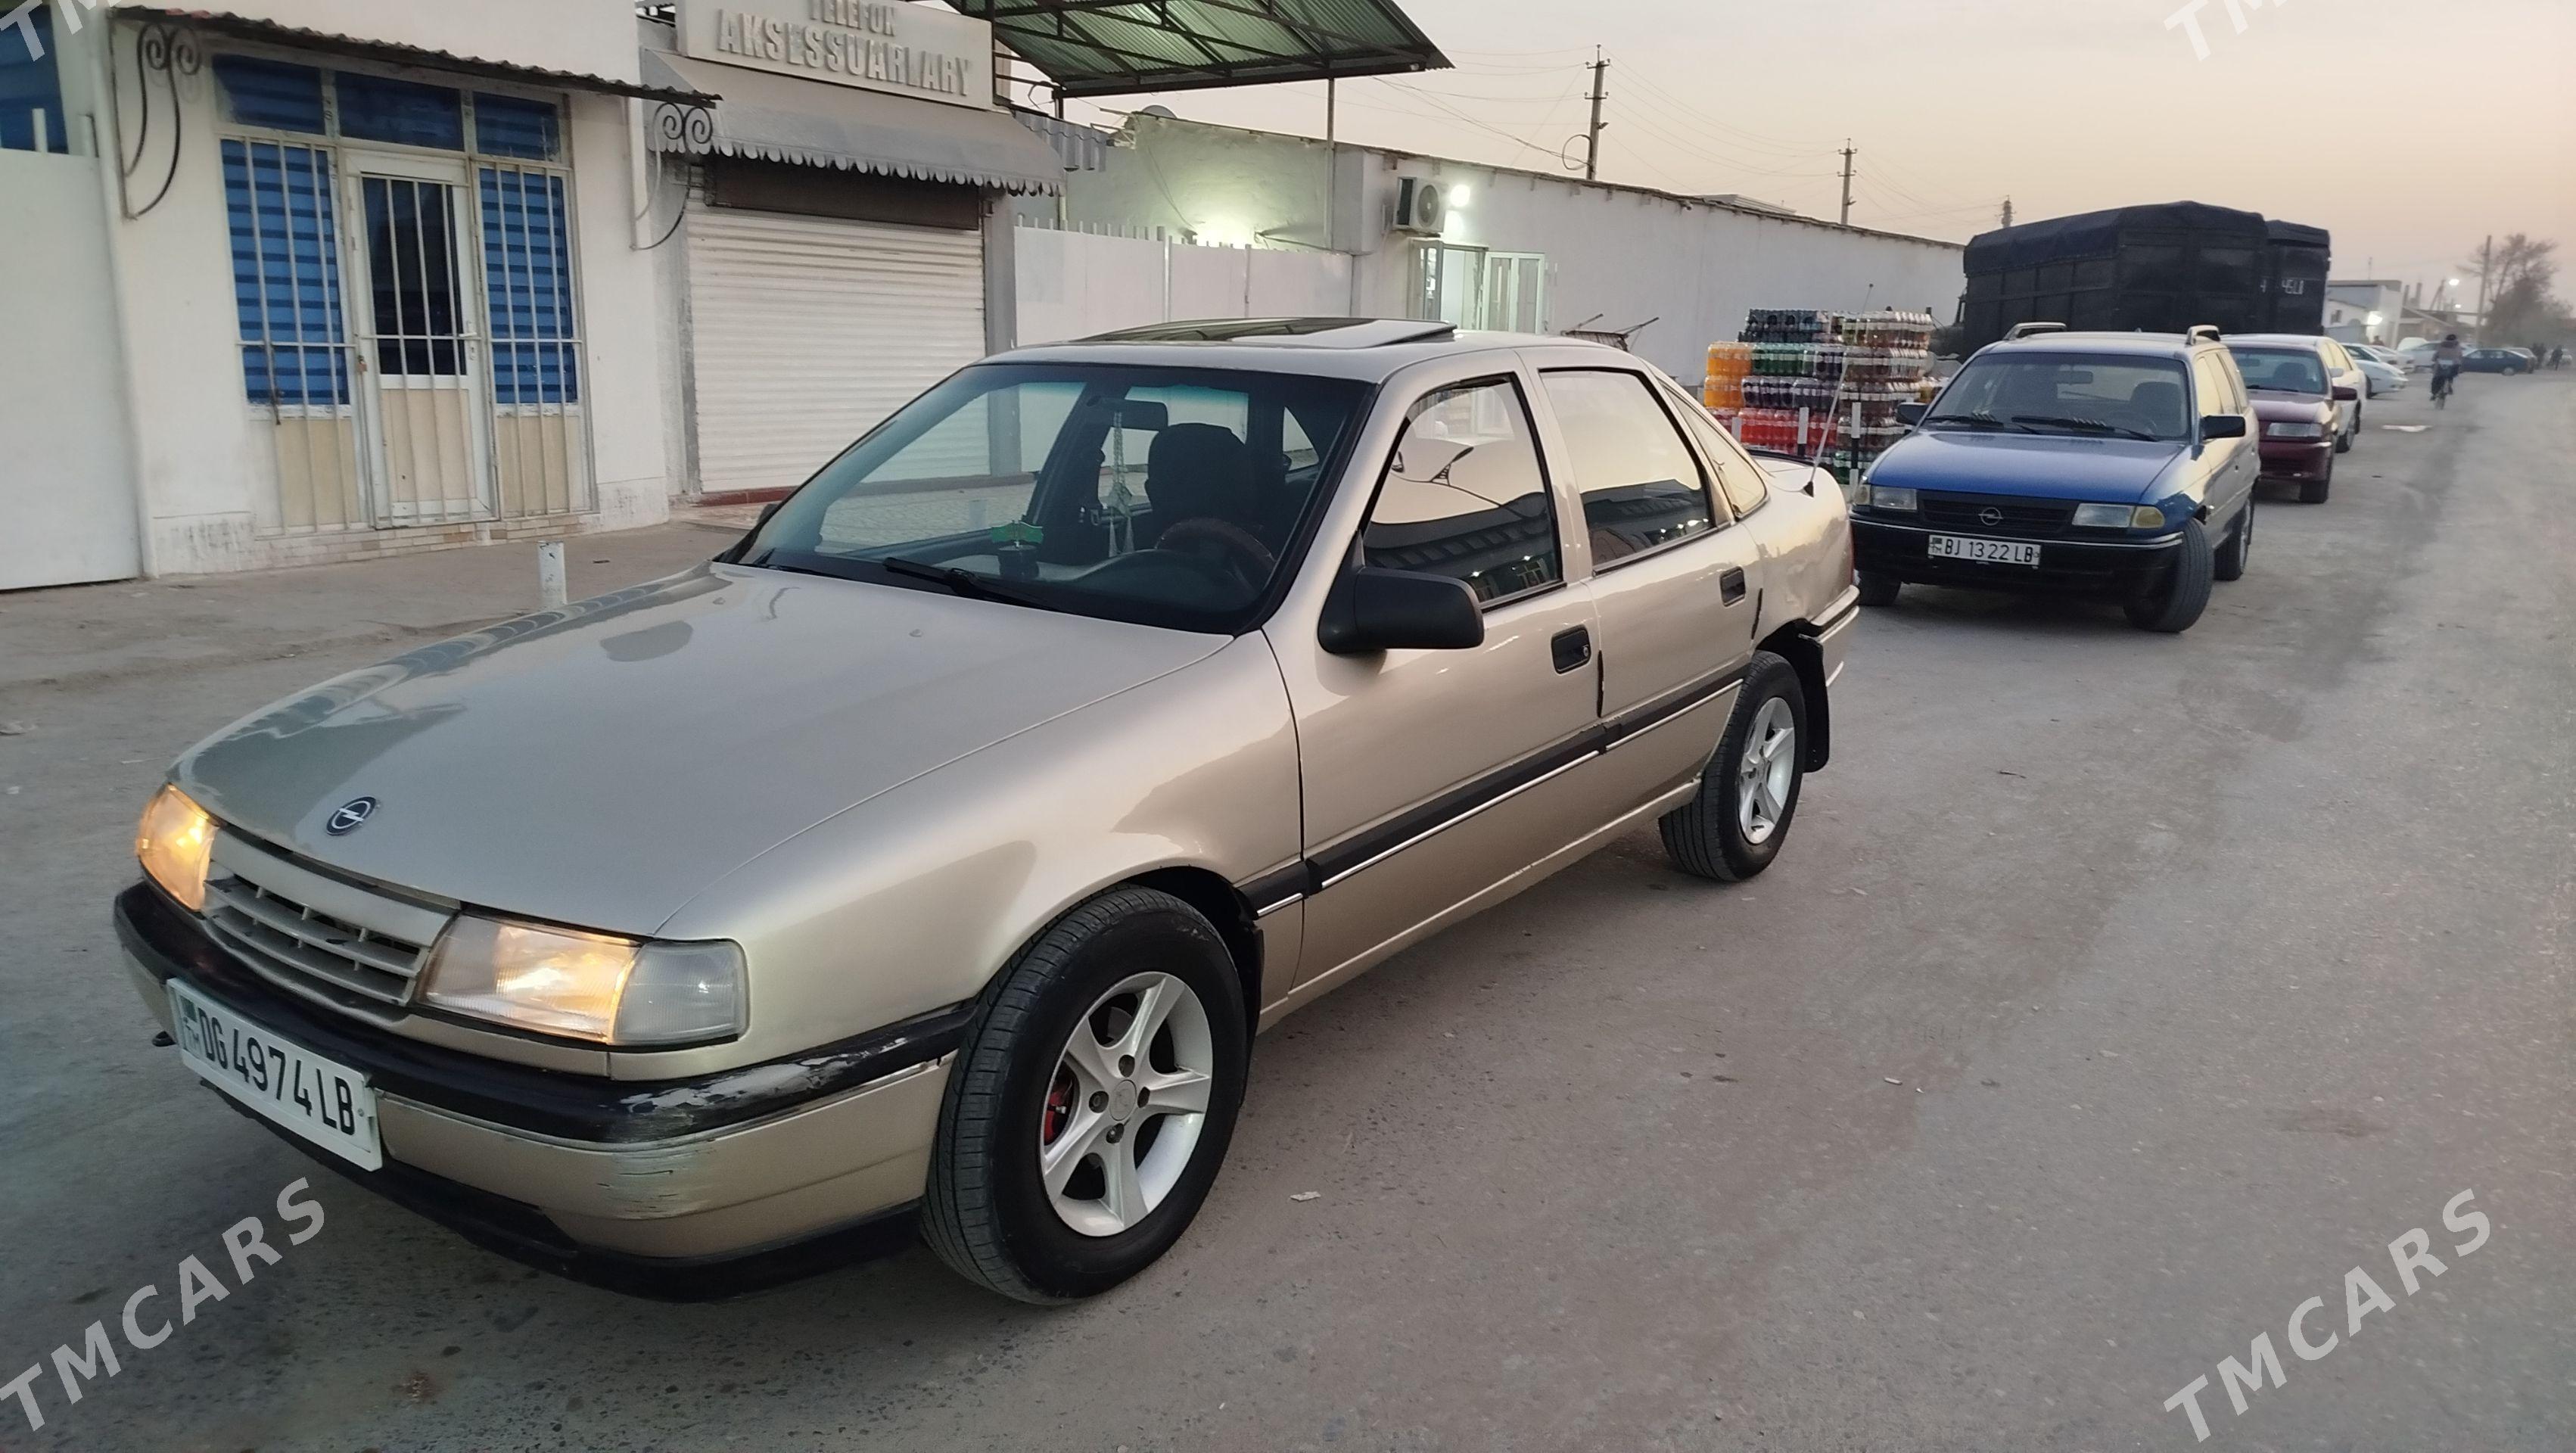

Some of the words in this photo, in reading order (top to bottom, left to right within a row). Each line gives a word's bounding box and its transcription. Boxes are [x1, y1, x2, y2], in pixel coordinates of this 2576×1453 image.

[717, 8, 969, 95] AKSESSUARLARY
[1969, 541, 2009, 561] 1322
[2014, 546, 2033, 563] LB
